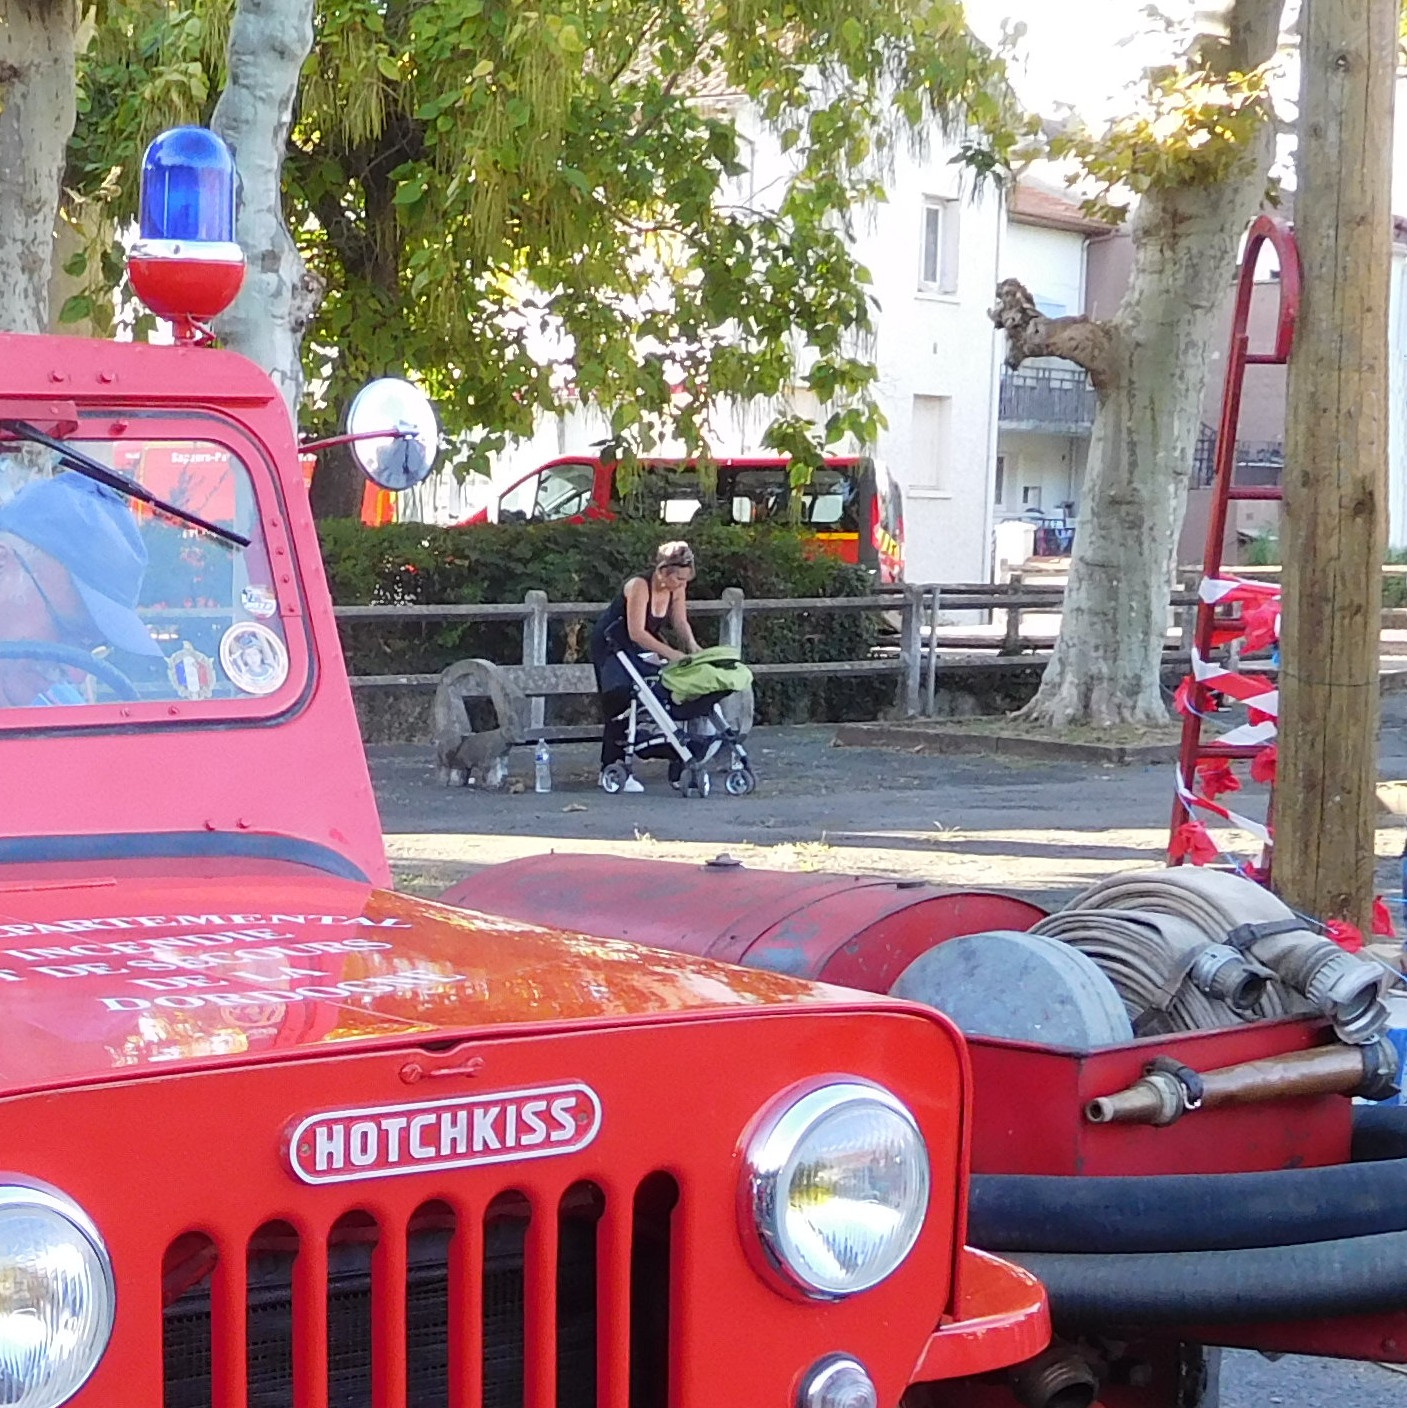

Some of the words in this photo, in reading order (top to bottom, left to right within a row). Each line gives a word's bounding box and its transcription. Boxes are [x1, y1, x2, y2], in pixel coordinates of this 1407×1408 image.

[26, 962, 130, 978] DE
[127, 938, 392, 971] SECOURS
[126, 975, 229, 991] DE
[227, 966, 332, 983] LA
[315, 1097, 577, 1171] HOTCHKISS
